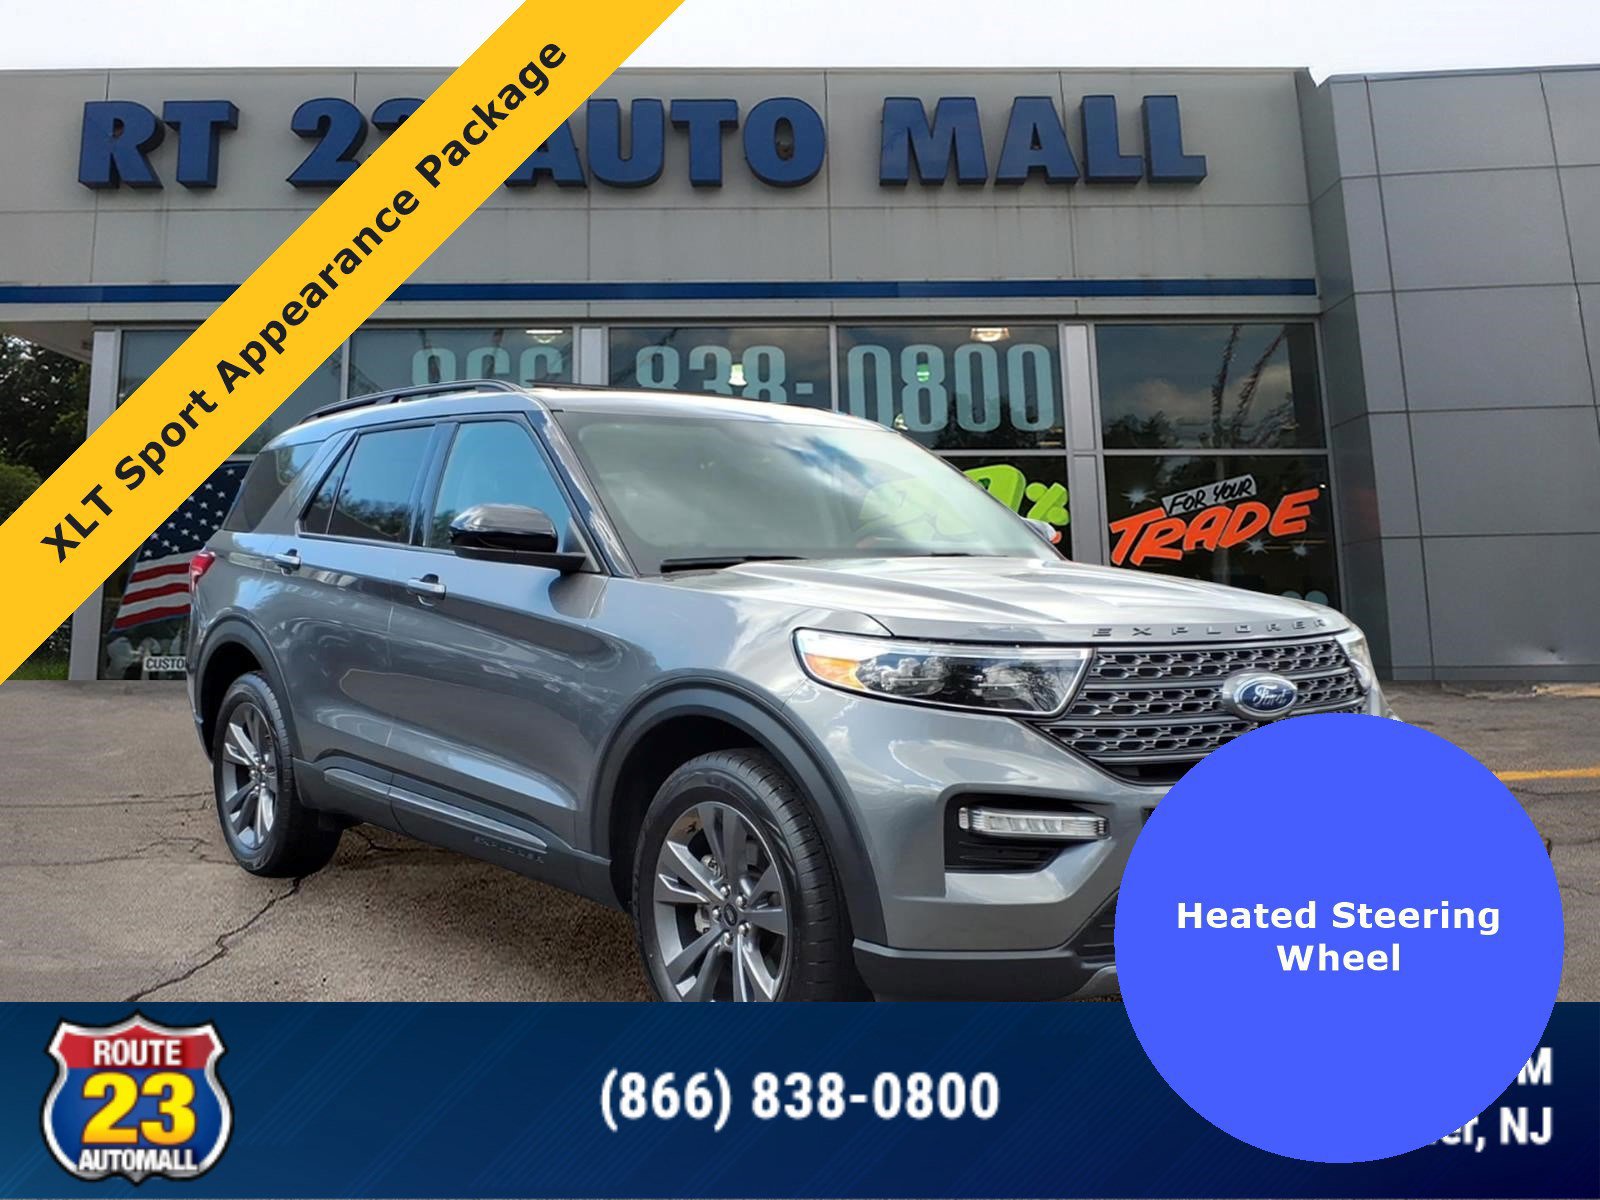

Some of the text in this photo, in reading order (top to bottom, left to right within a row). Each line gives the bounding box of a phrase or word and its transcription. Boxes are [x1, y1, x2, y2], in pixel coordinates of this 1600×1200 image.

[78, 100, 240, 189] RT
[286, 97, 426, 188] 2
[879, 94, 1208, 186] MALL
[1168, 478, 1254, 515] FOR YOUR
[1109, 488, 1321, 567] TRADE
[1092, 618, 1328, 638] EXPLORER
[1252, 684, 1292, 706] Ford
